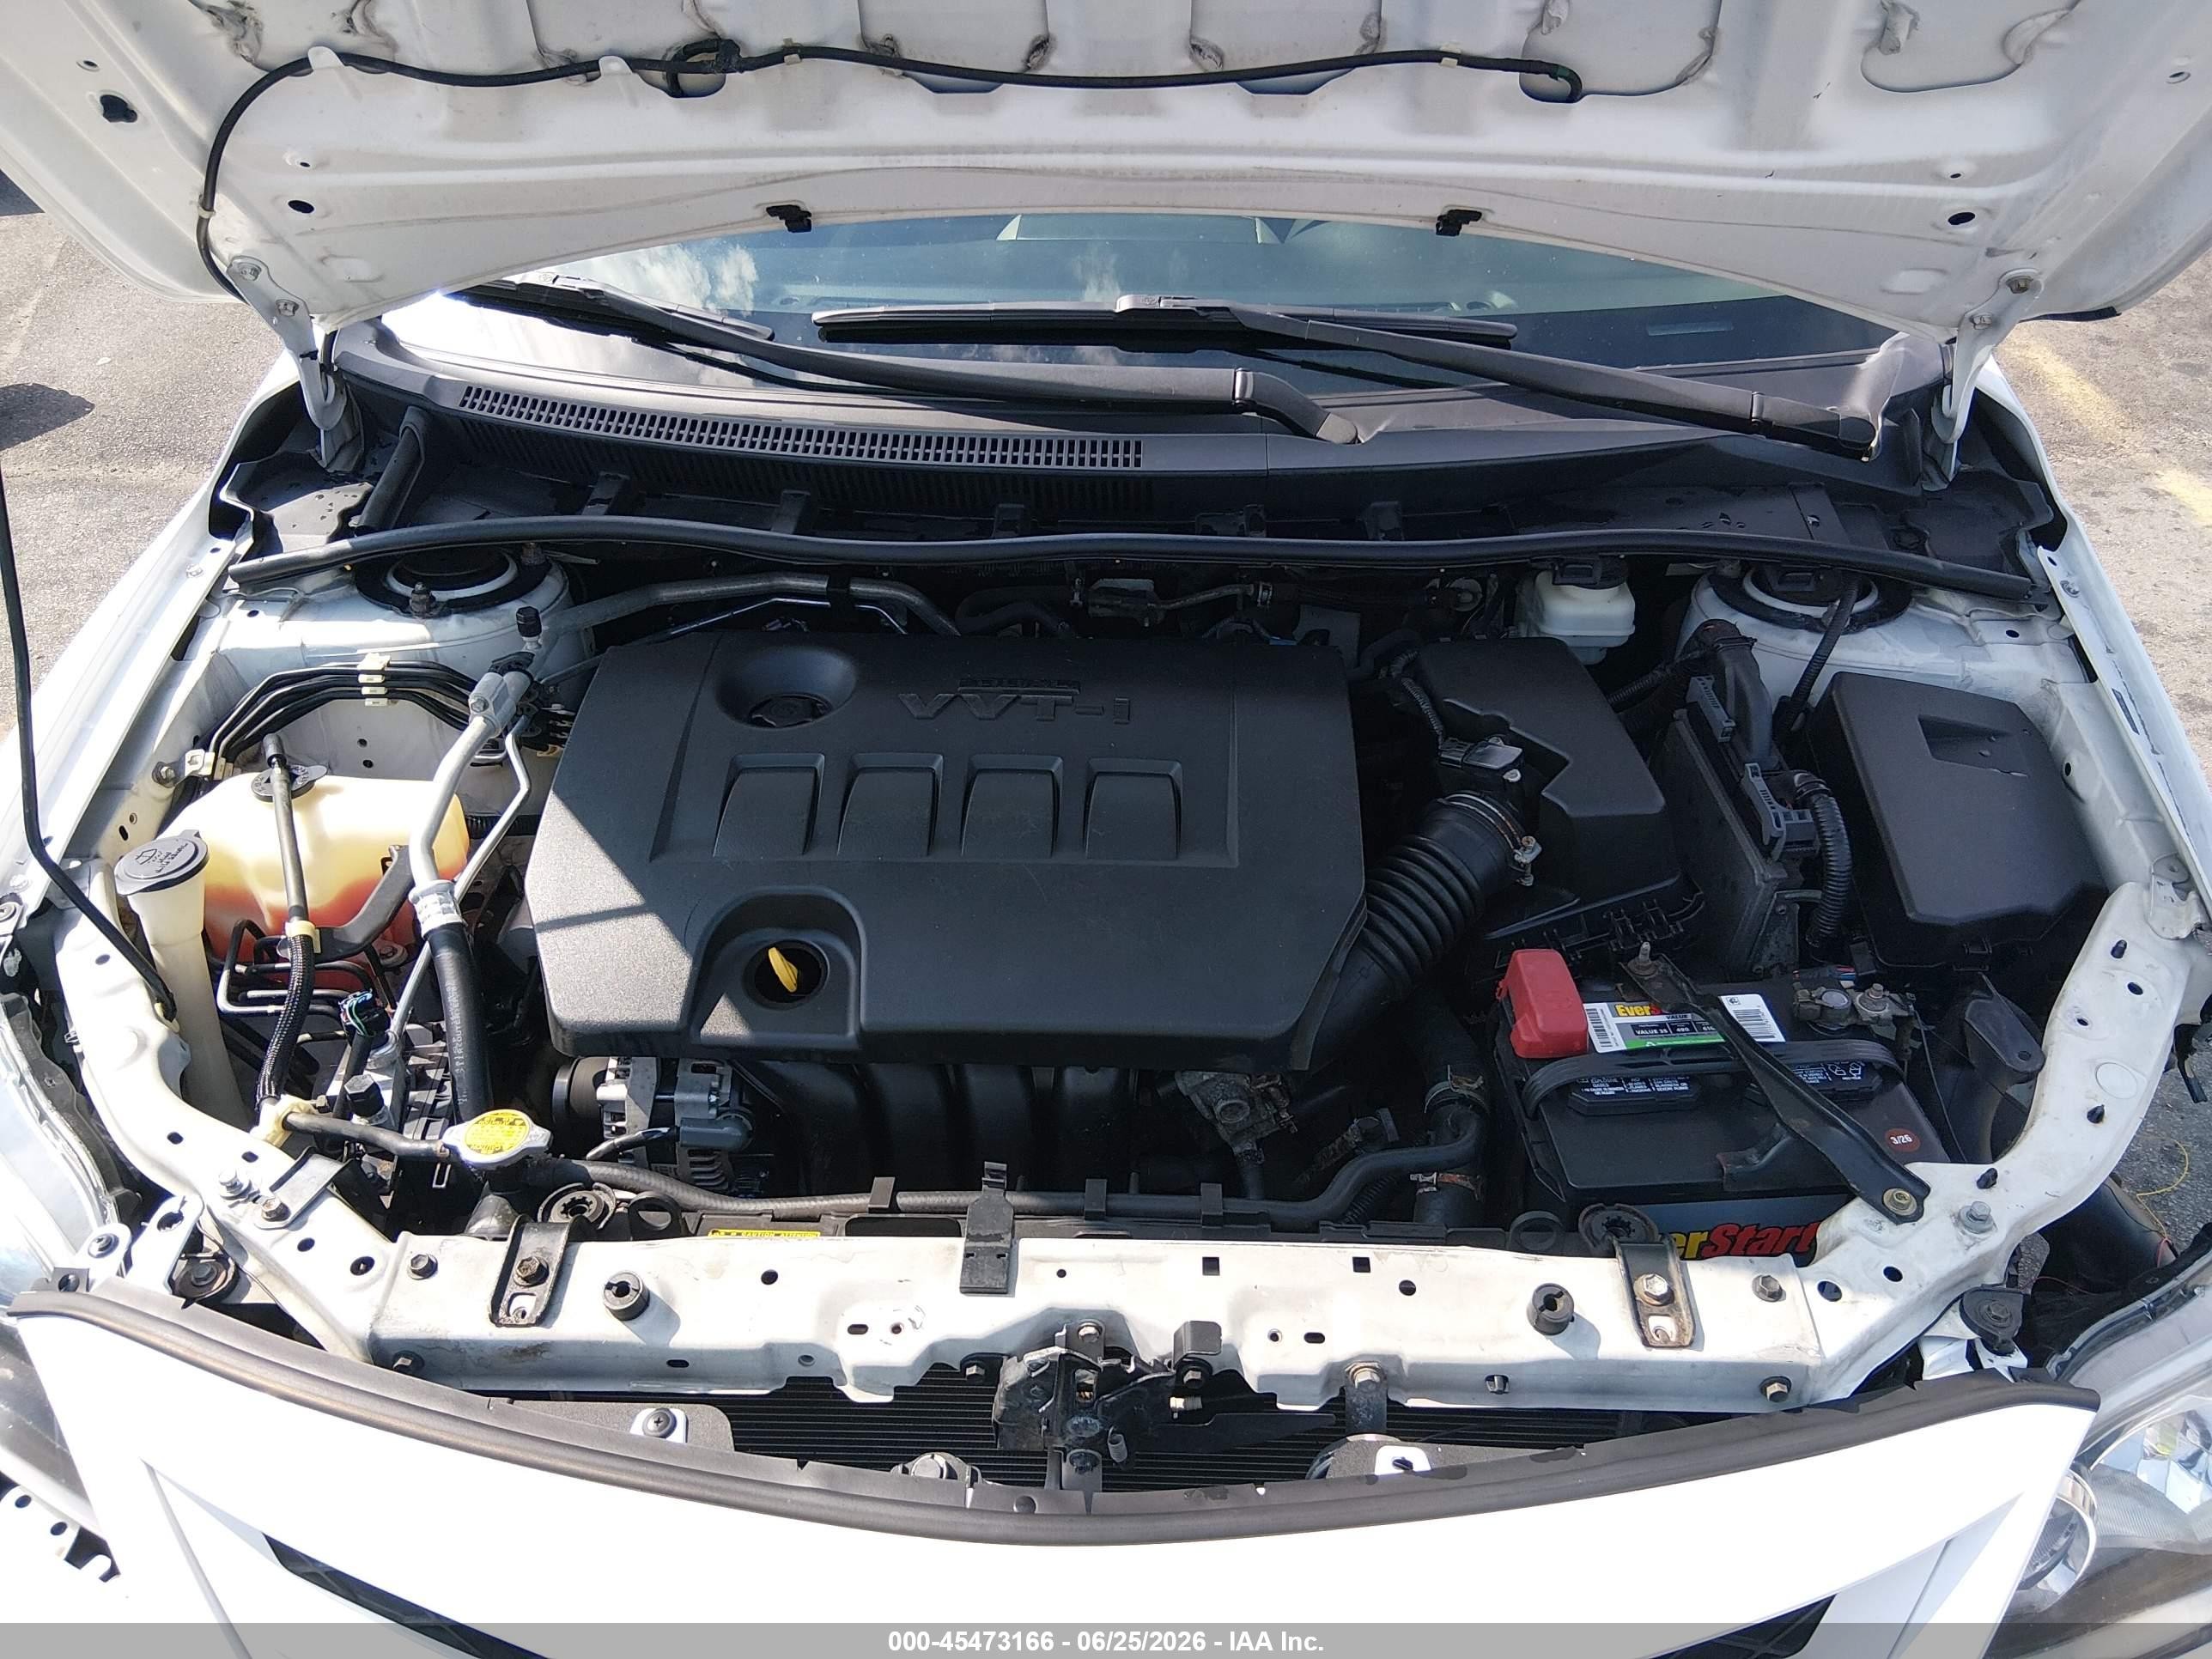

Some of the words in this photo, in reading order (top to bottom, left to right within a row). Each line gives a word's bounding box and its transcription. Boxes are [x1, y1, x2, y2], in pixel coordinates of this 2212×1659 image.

[1614, 1004, 1663, 1017] EverS
[1889, 1133, 1913, 1146] 3/26
[1667, 1221, 1821, 1260] erStart
